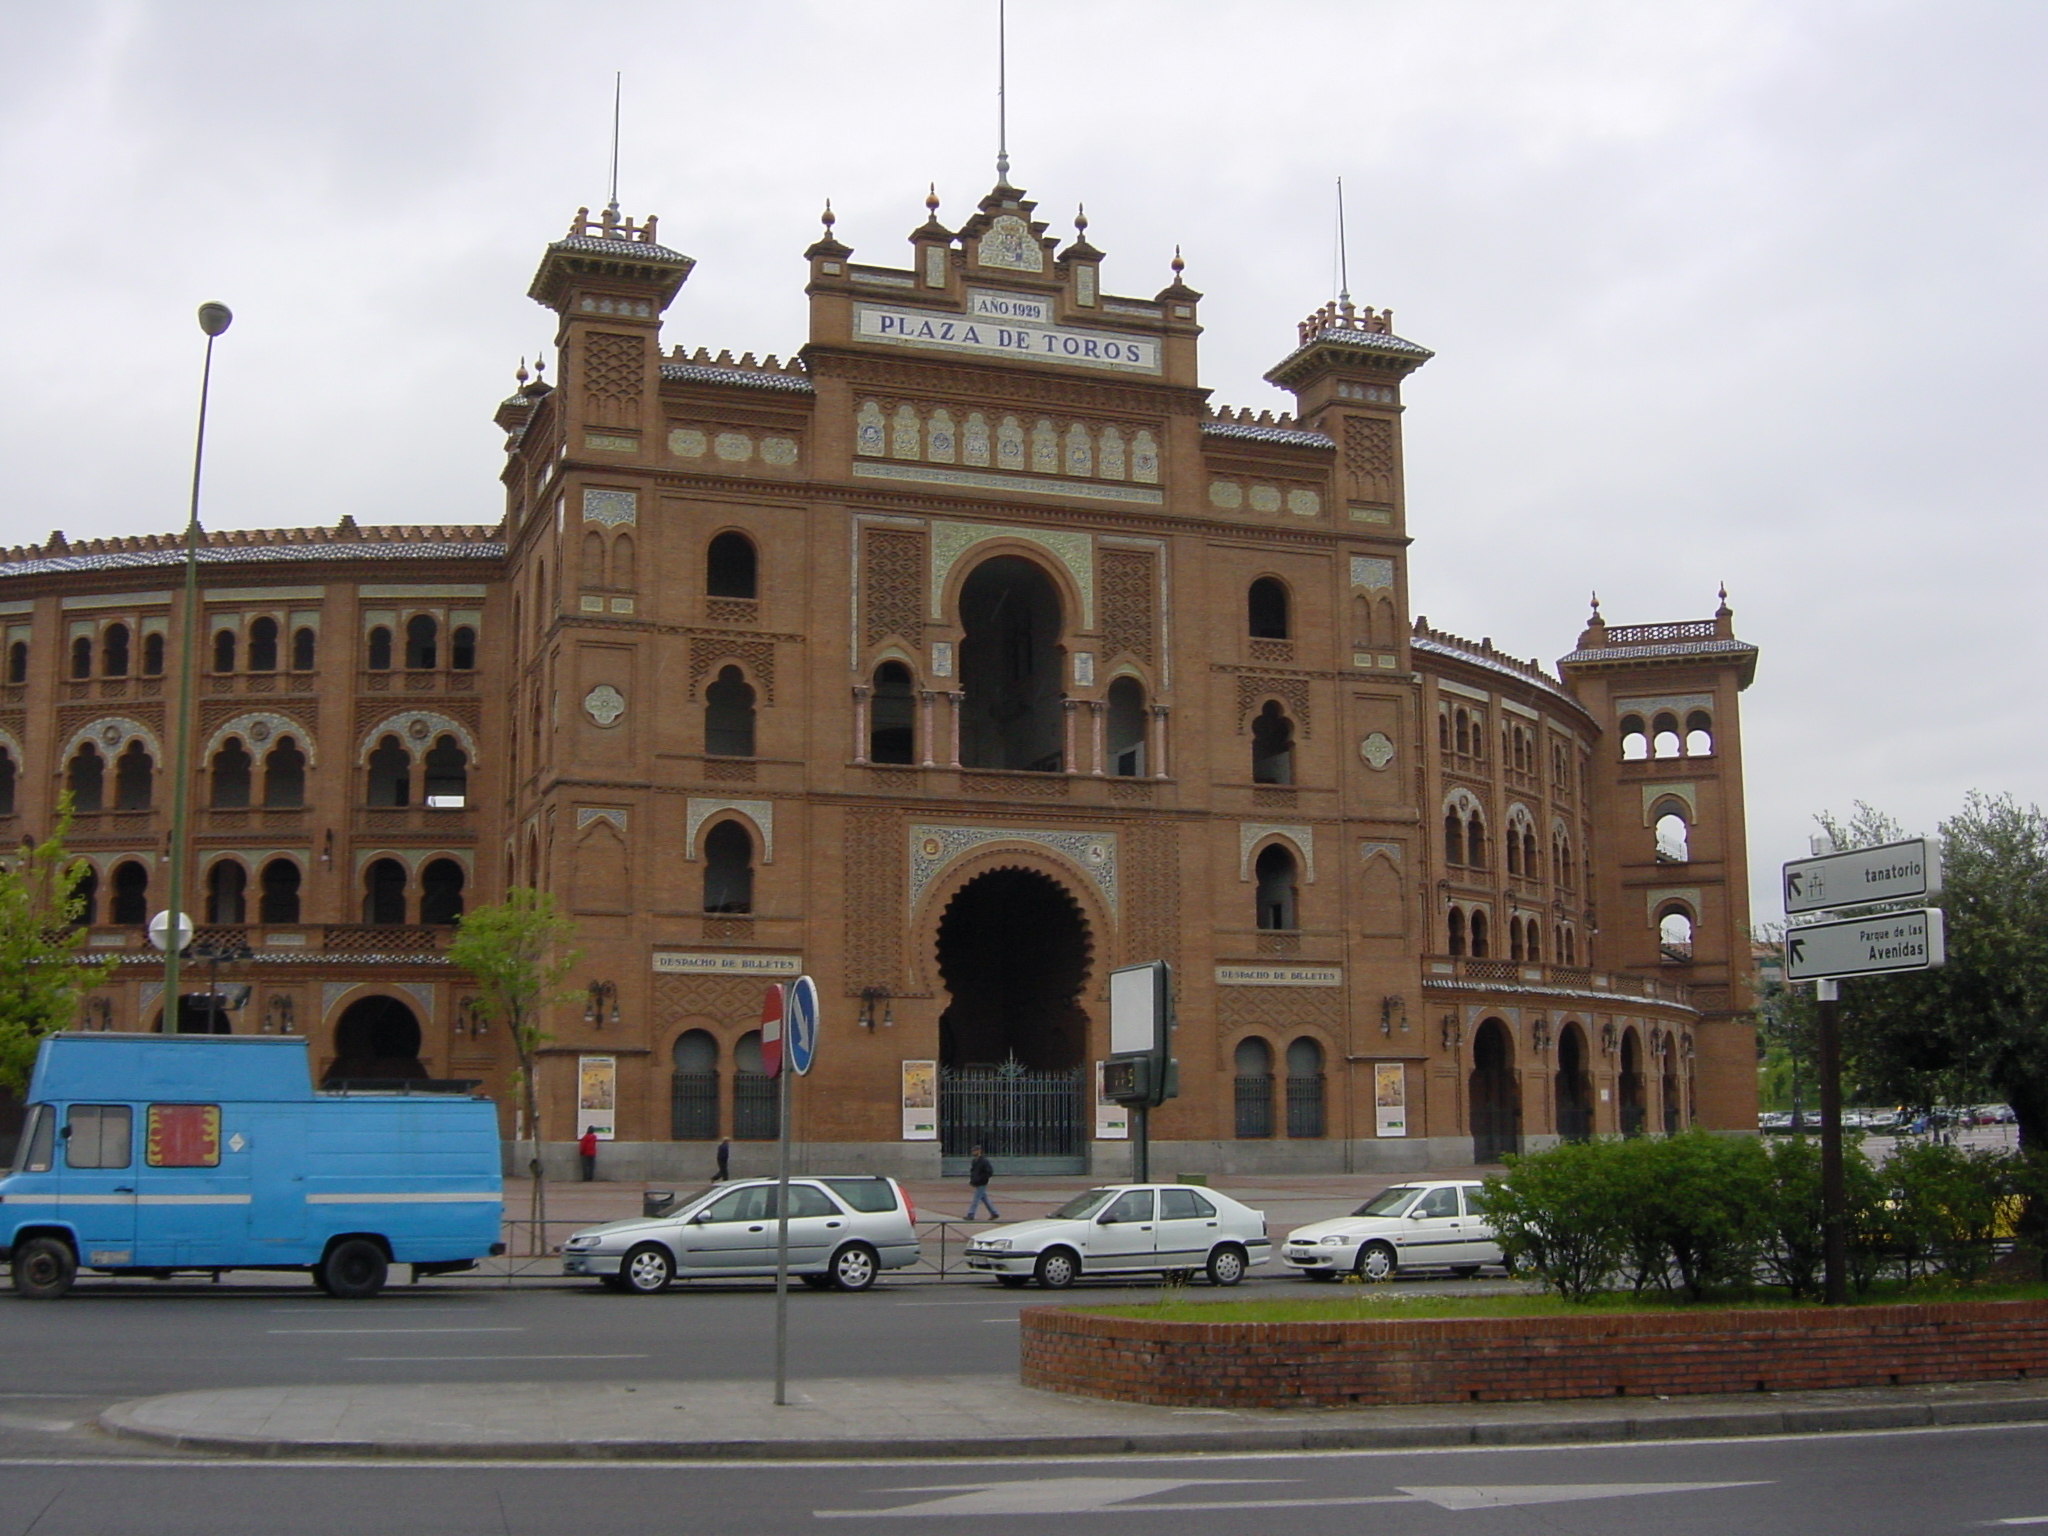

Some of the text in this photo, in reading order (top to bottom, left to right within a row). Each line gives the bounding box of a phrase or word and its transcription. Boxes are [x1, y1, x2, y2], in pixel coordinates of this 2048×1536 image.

[978, 296, 1041, 319] AÑO 1929
[880, 315, 1141, 363] PLAZA DE TOROS
[1865, 861, 1921, 883] tanatorio
[1860, 925, 1923, 943] Parque de las
[1869, 942, 1923, 961] Avenidas
[660, 957, 794, 968] DESPACHO DE BILLETES
[1221, 970, 1335, 980] DESPACHO DE BILLETES
